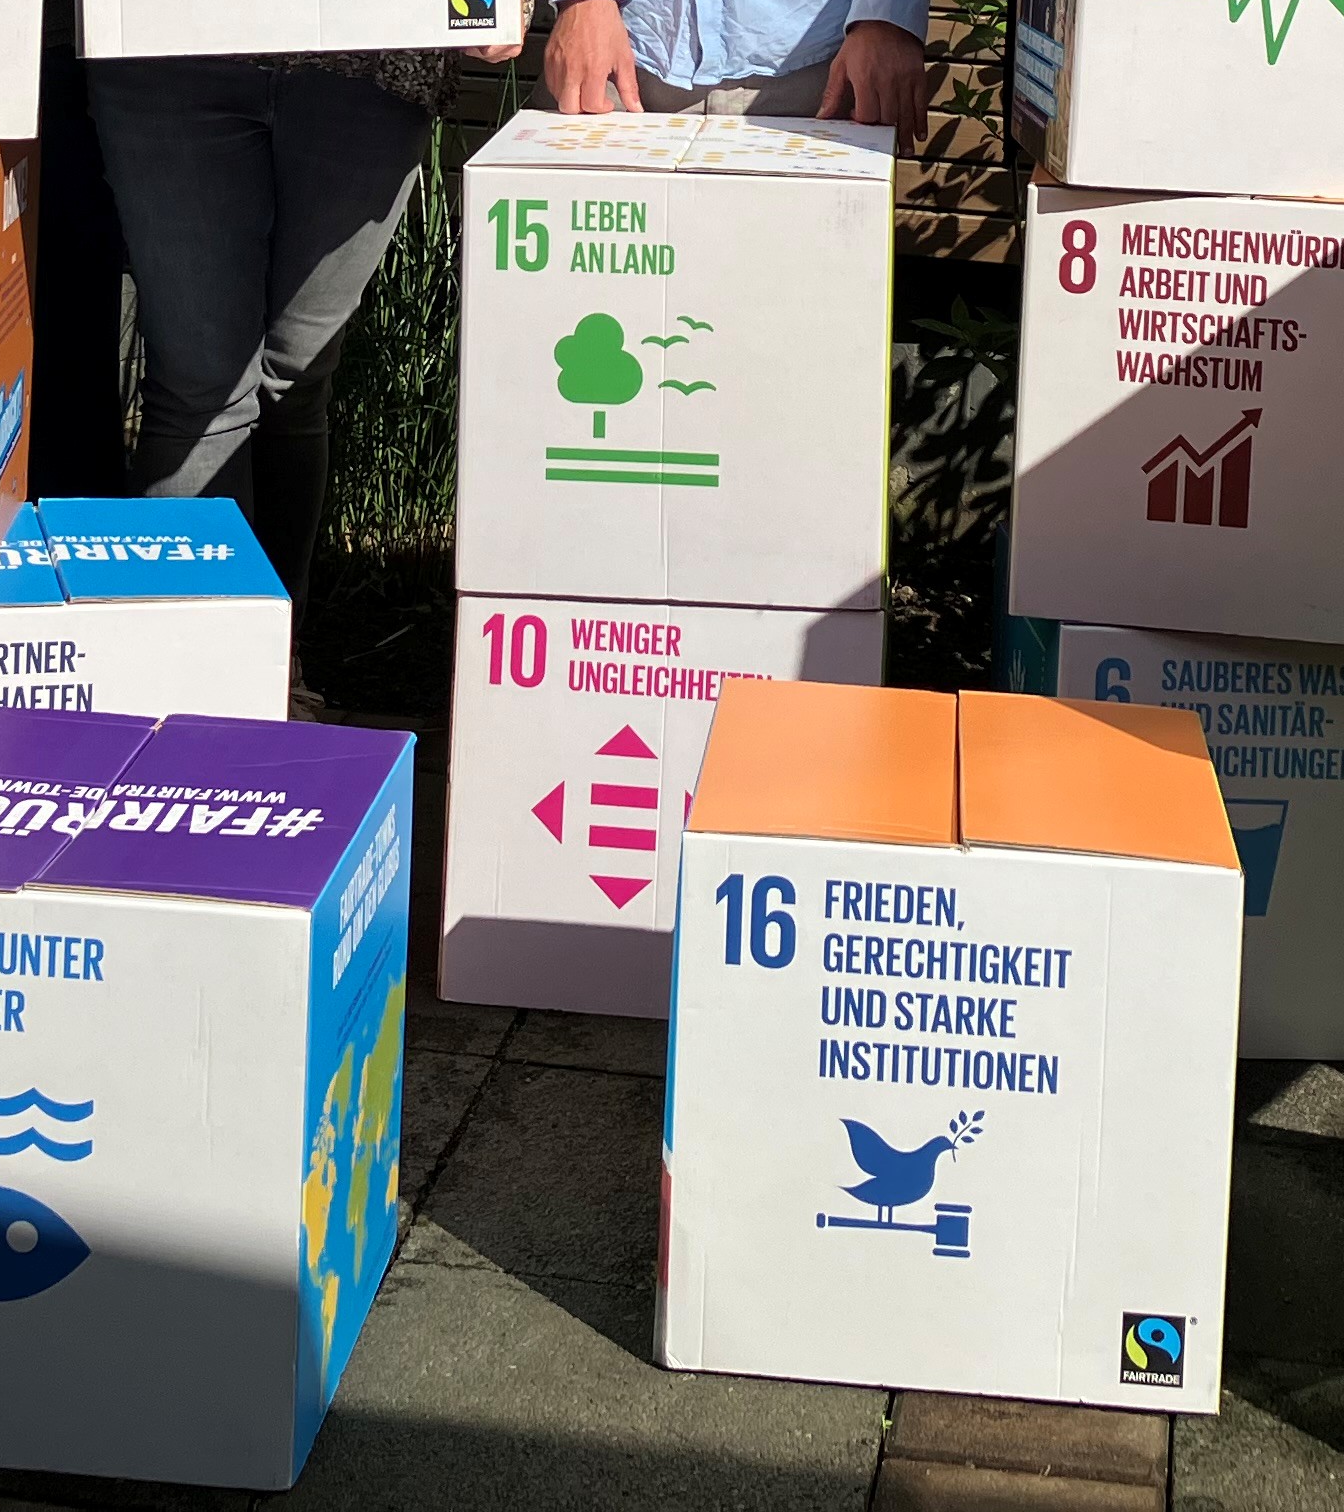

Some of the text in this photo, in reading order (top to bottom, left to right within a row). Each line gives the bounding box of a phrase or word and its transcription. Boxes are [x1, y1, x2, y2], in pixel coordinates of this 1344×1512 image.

[487, 198, 550, 272] 15
[571, 199, 647, 233] LEBEN
[570, 242, 675, 276] AN LAND
[1058, 219, 1097, 294] 8
[1119, 266, 1267, 307] ARBEIT UND
[1119, 308, 1307, 352] WIRTSCHAFTS-
[1116, 350, 1263, 392] WACHSTUM
[483, 613, 547, 688] 10
[571, 618, 682, 657] WENIGER
[569, 660, 773, 701] UNGLEICHHE
[1095, 657, 1131, 703] 6
[1161, 659, 1292, 695] SAUBERES
[1218, 700, 1334, 738] SANITÄR-
[716, 873, 796, 969] 16
[824, 879, 964, 930] FRIEDEN,
[822, 935, 1072, 988] GERECHTIGKEIT
[821, 985, 1017, 1040] UND STARKE
[818, 1039, 1058, 1094] INSTITUTIONEN
[1123, 1371, 1179, 1382] FAIRTRADE
